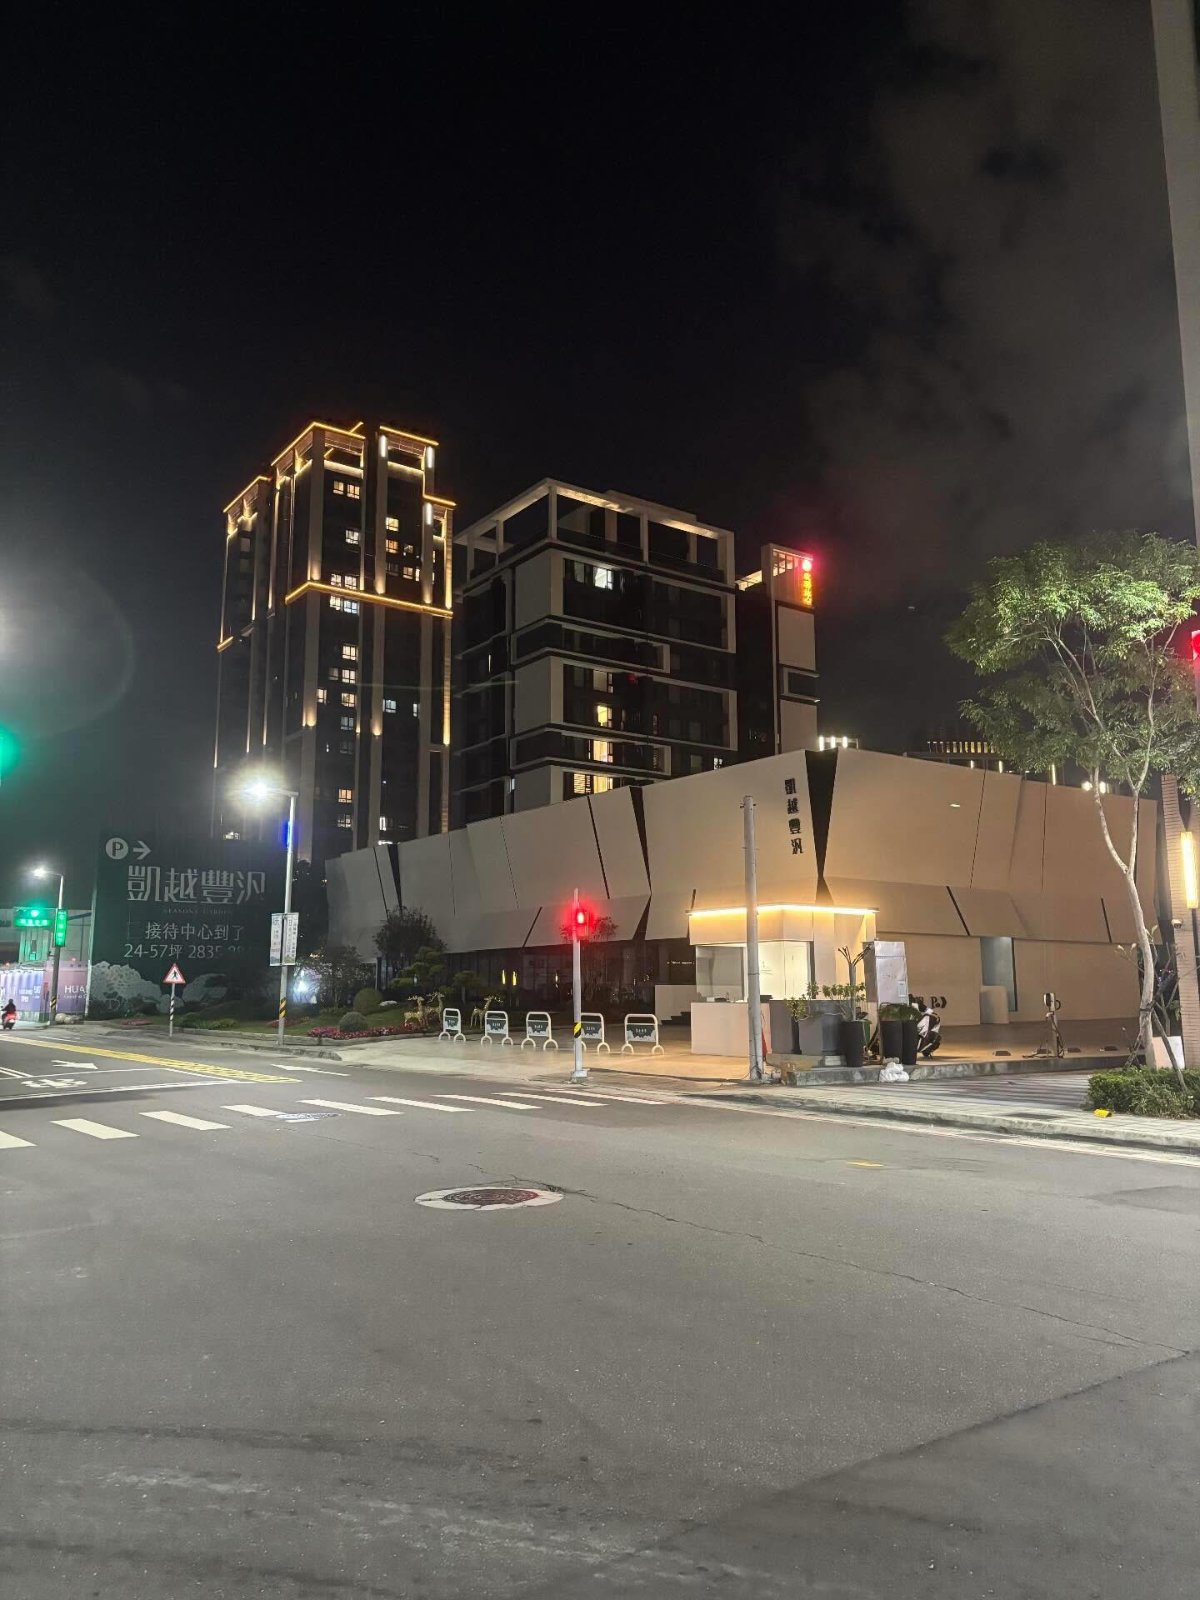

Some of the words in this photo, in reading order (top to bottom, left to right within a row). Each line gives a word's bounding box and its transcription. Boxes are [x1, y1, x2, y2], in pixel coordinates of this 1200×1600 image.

[127, 865, 266, 905] 凱越豐汎
[145, 921, 244, 941] 接待中心到了
[124, 943, 184, 960] 24-57坪
[64, 985, 87, 994] HUA
